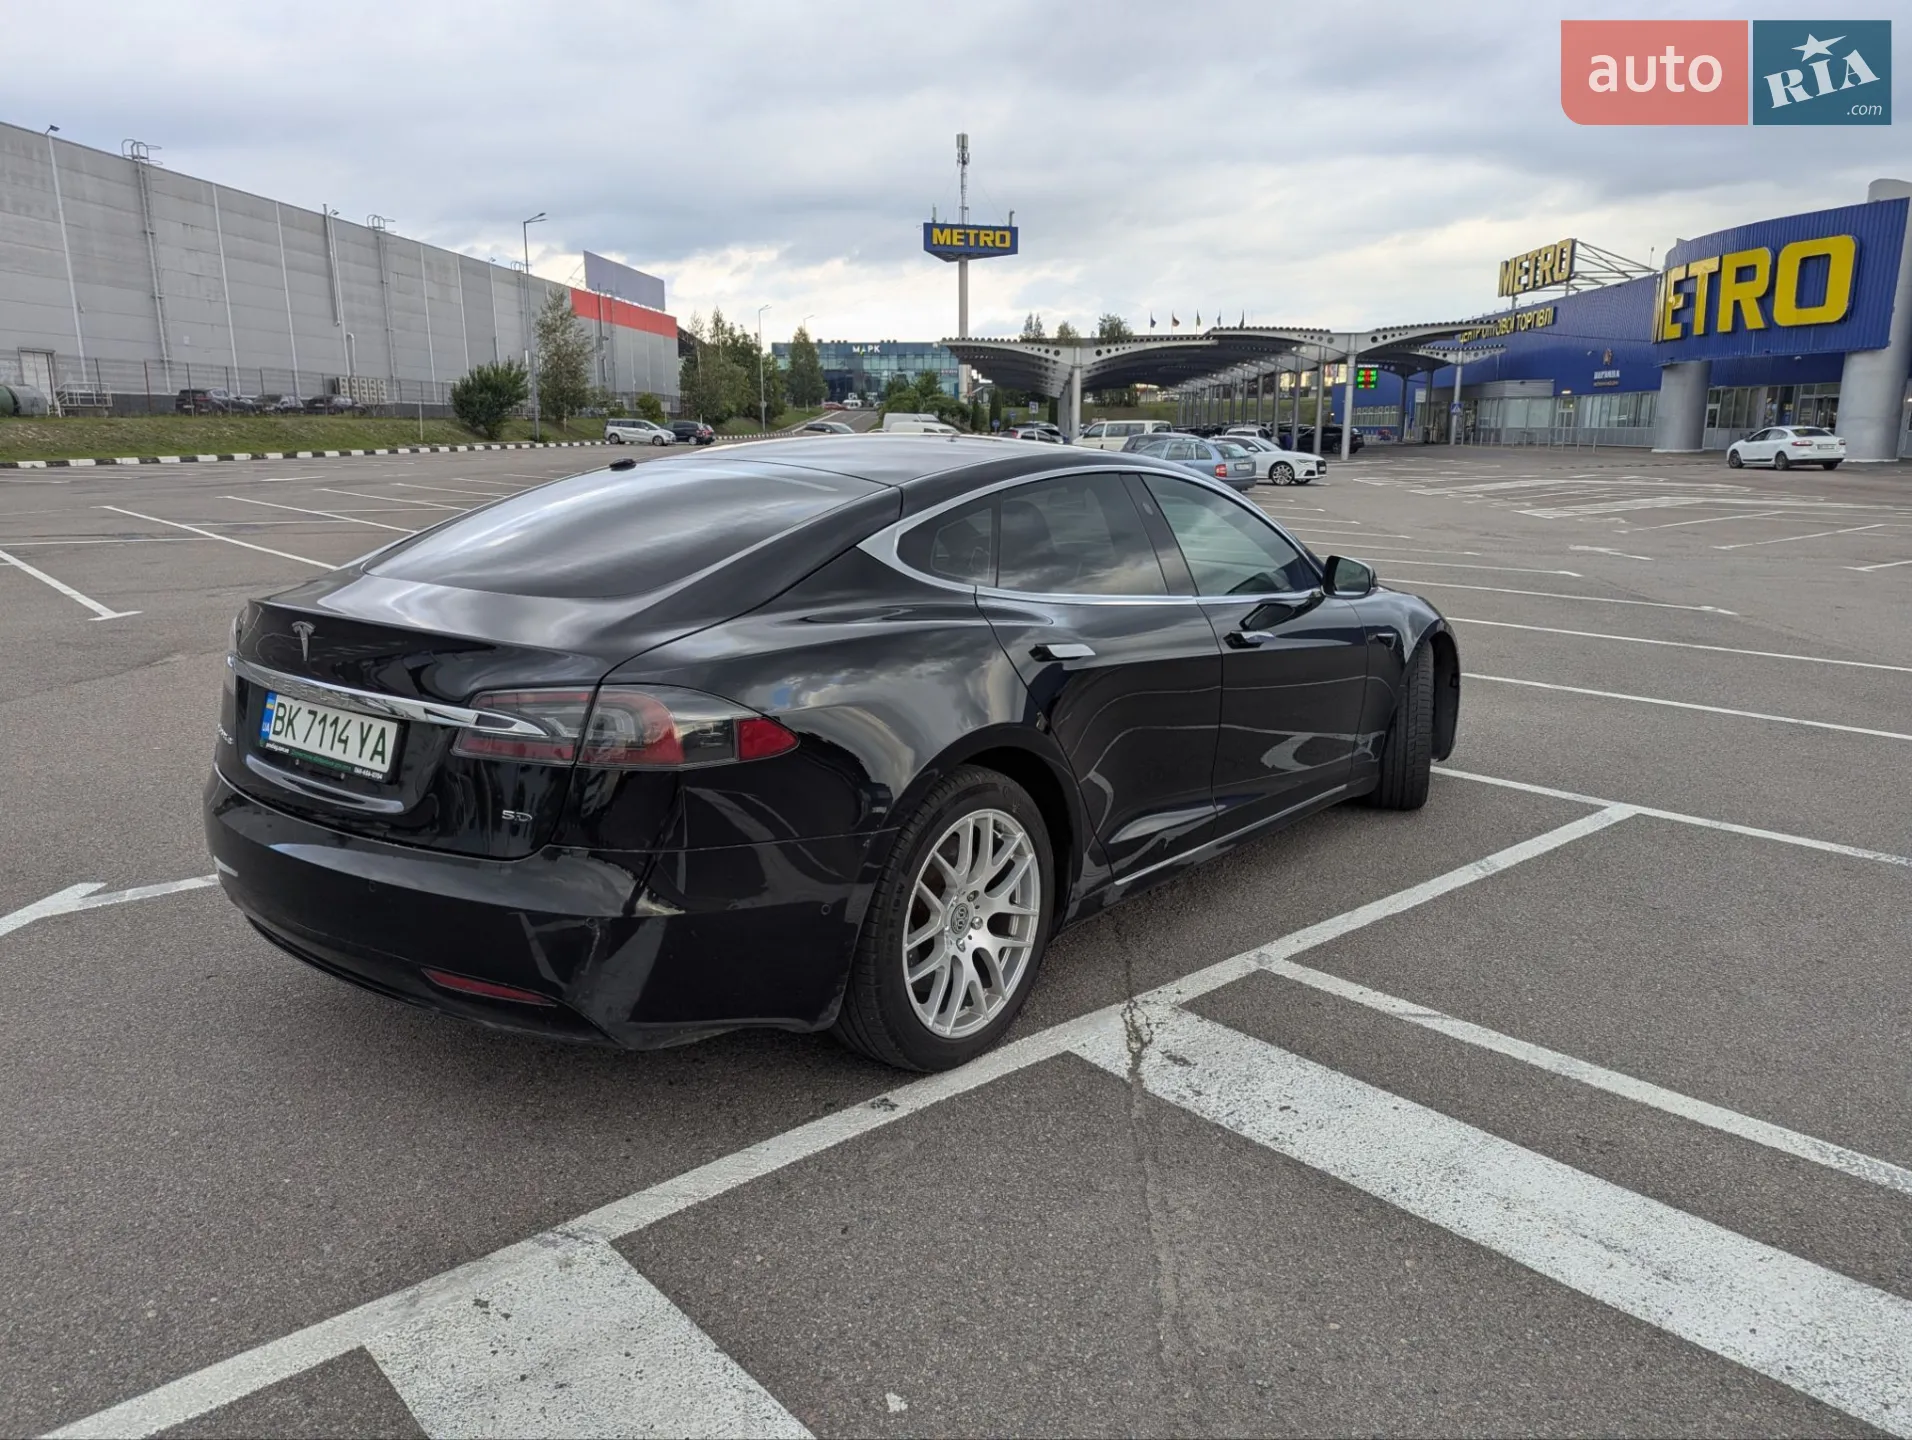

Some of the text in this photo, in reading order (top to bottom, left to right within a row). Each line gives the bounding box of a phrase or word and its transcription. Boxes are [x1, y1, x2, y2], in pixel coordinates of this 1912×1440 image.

[932, 227, 1011, 248] METRO
[1498, 238, 1574, 298] METRO
[272, 702, 302, 740] BK
[302, 709, 353, 755] 7114
[357, 721, 387, 765] YA
